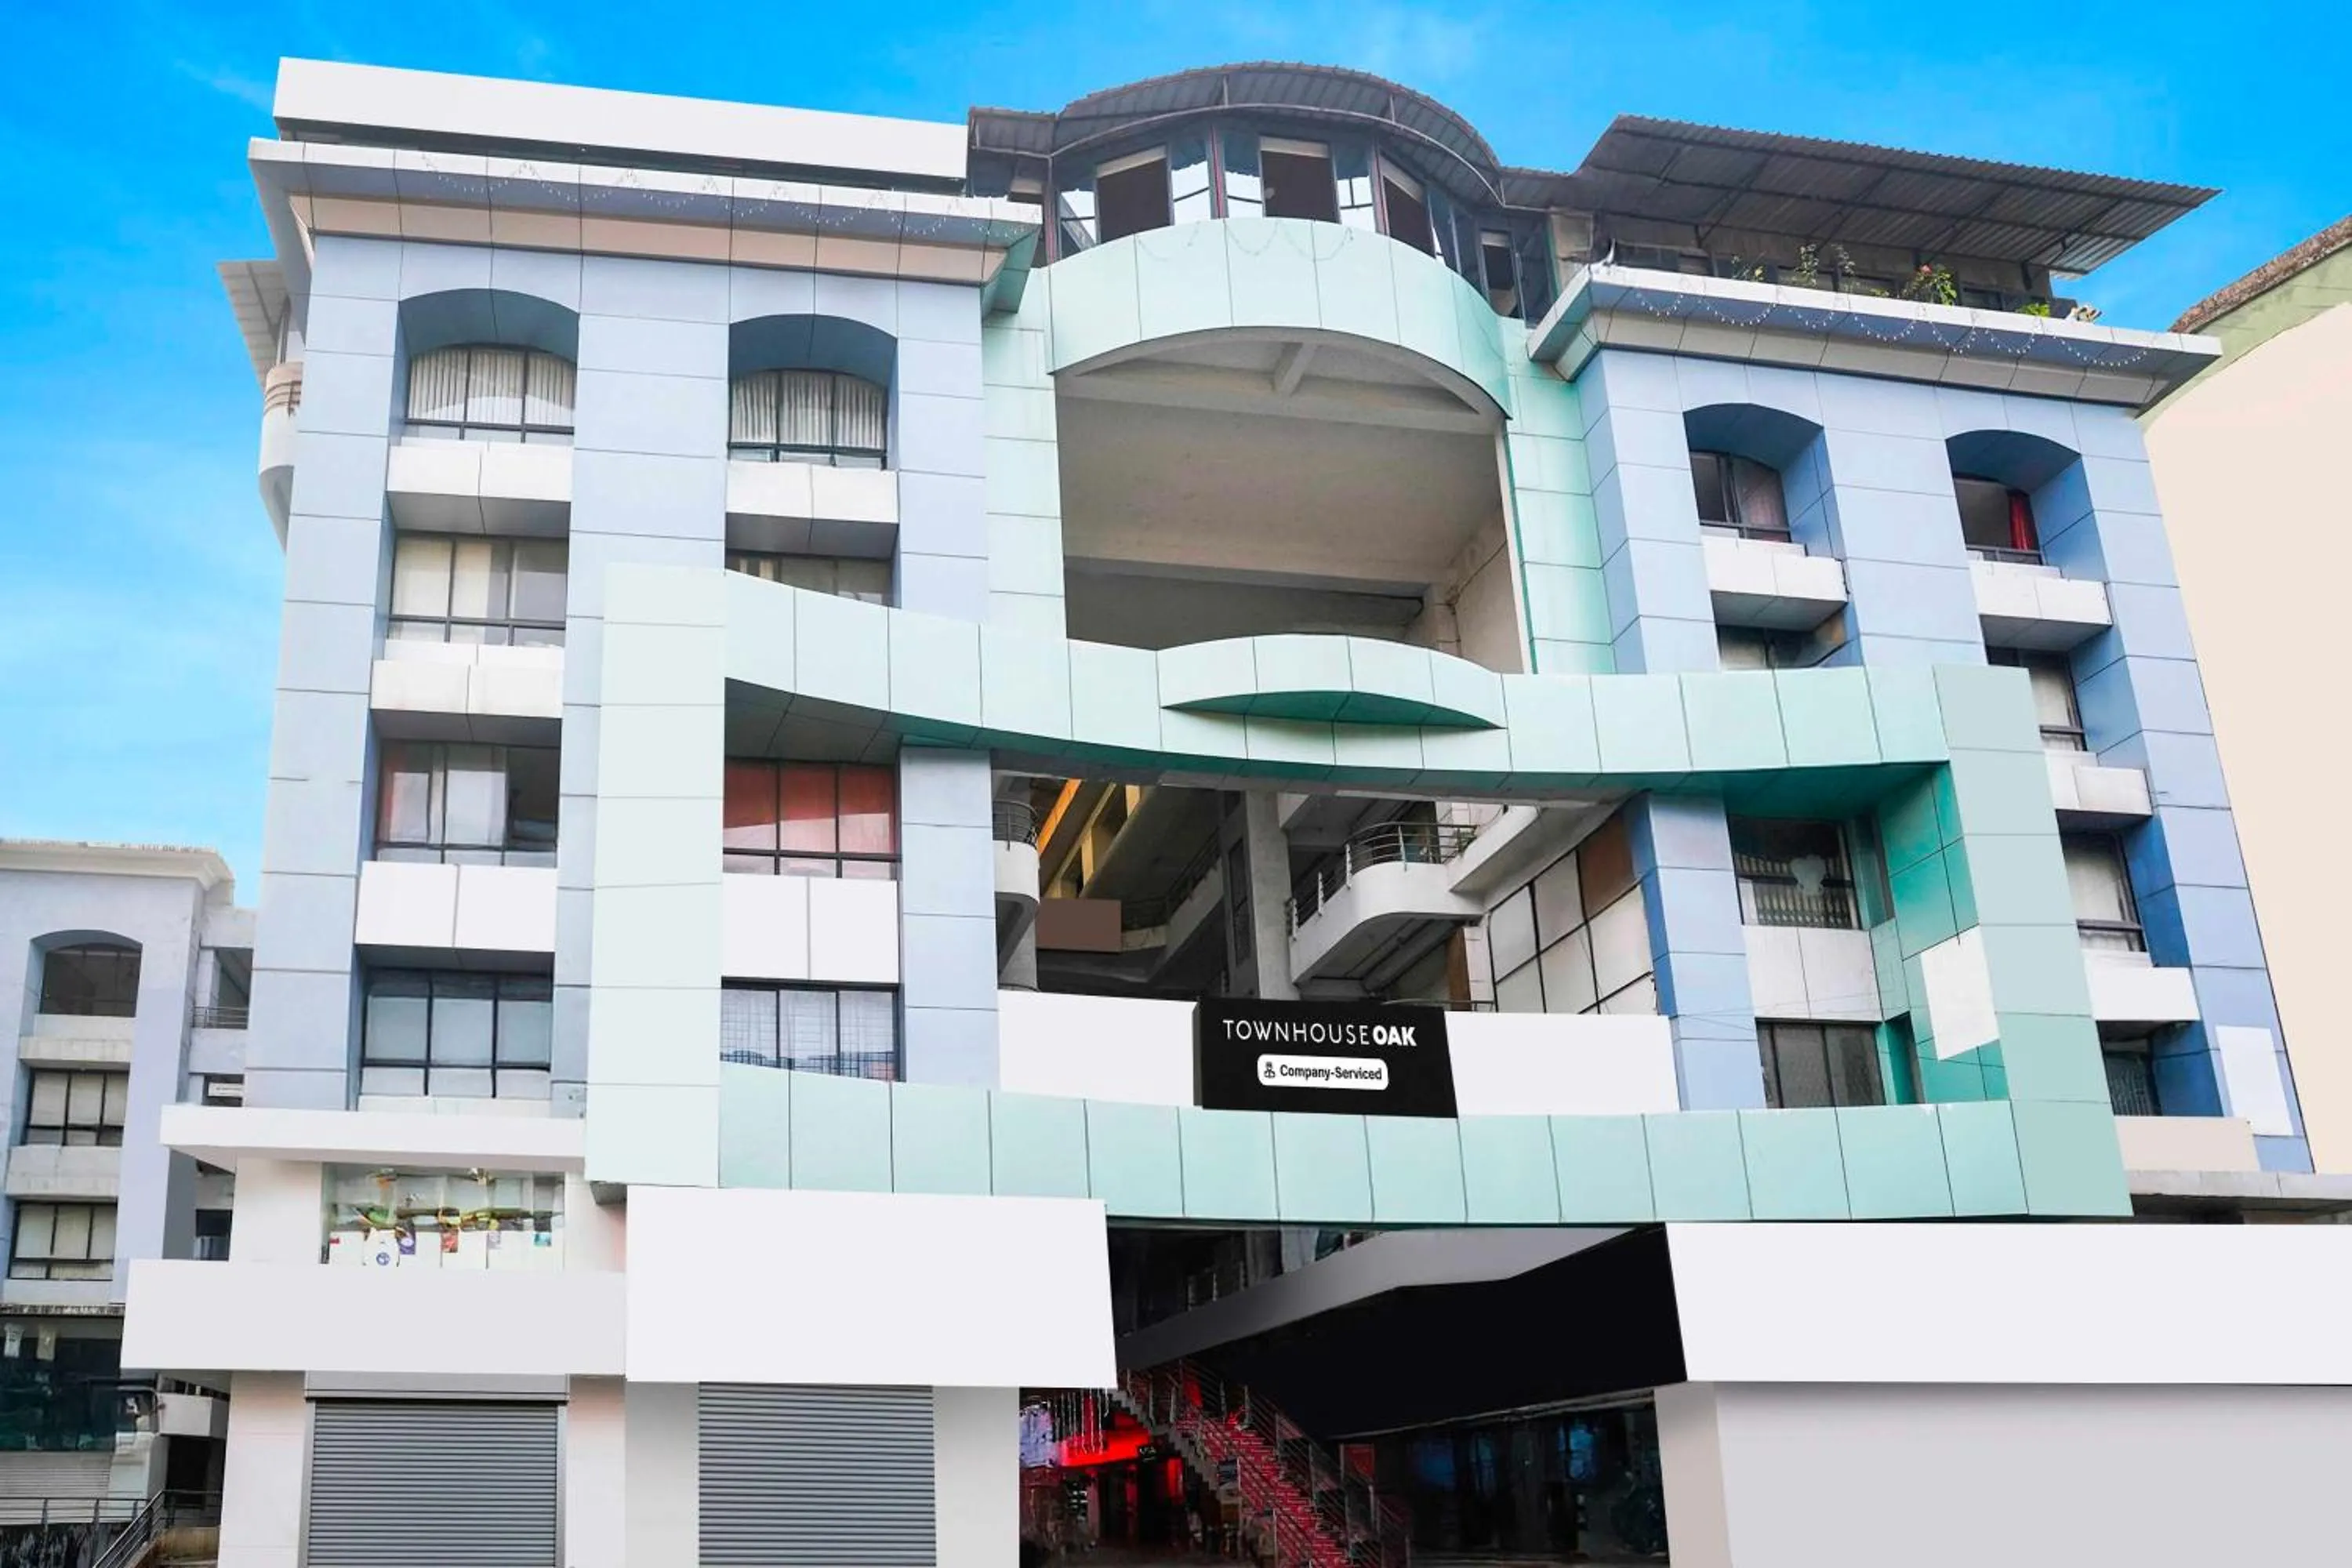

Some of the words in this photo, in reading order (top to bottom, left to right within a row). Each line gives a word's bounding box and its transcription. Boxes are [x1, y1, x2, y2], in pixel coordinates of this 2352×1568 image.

[1222, 1019, 1370, 1045] TOWNHOUSE
[1372, 1025, 1417, 1047] OAK
[1279, 1064, 1382, 1081] Company-Serviced
